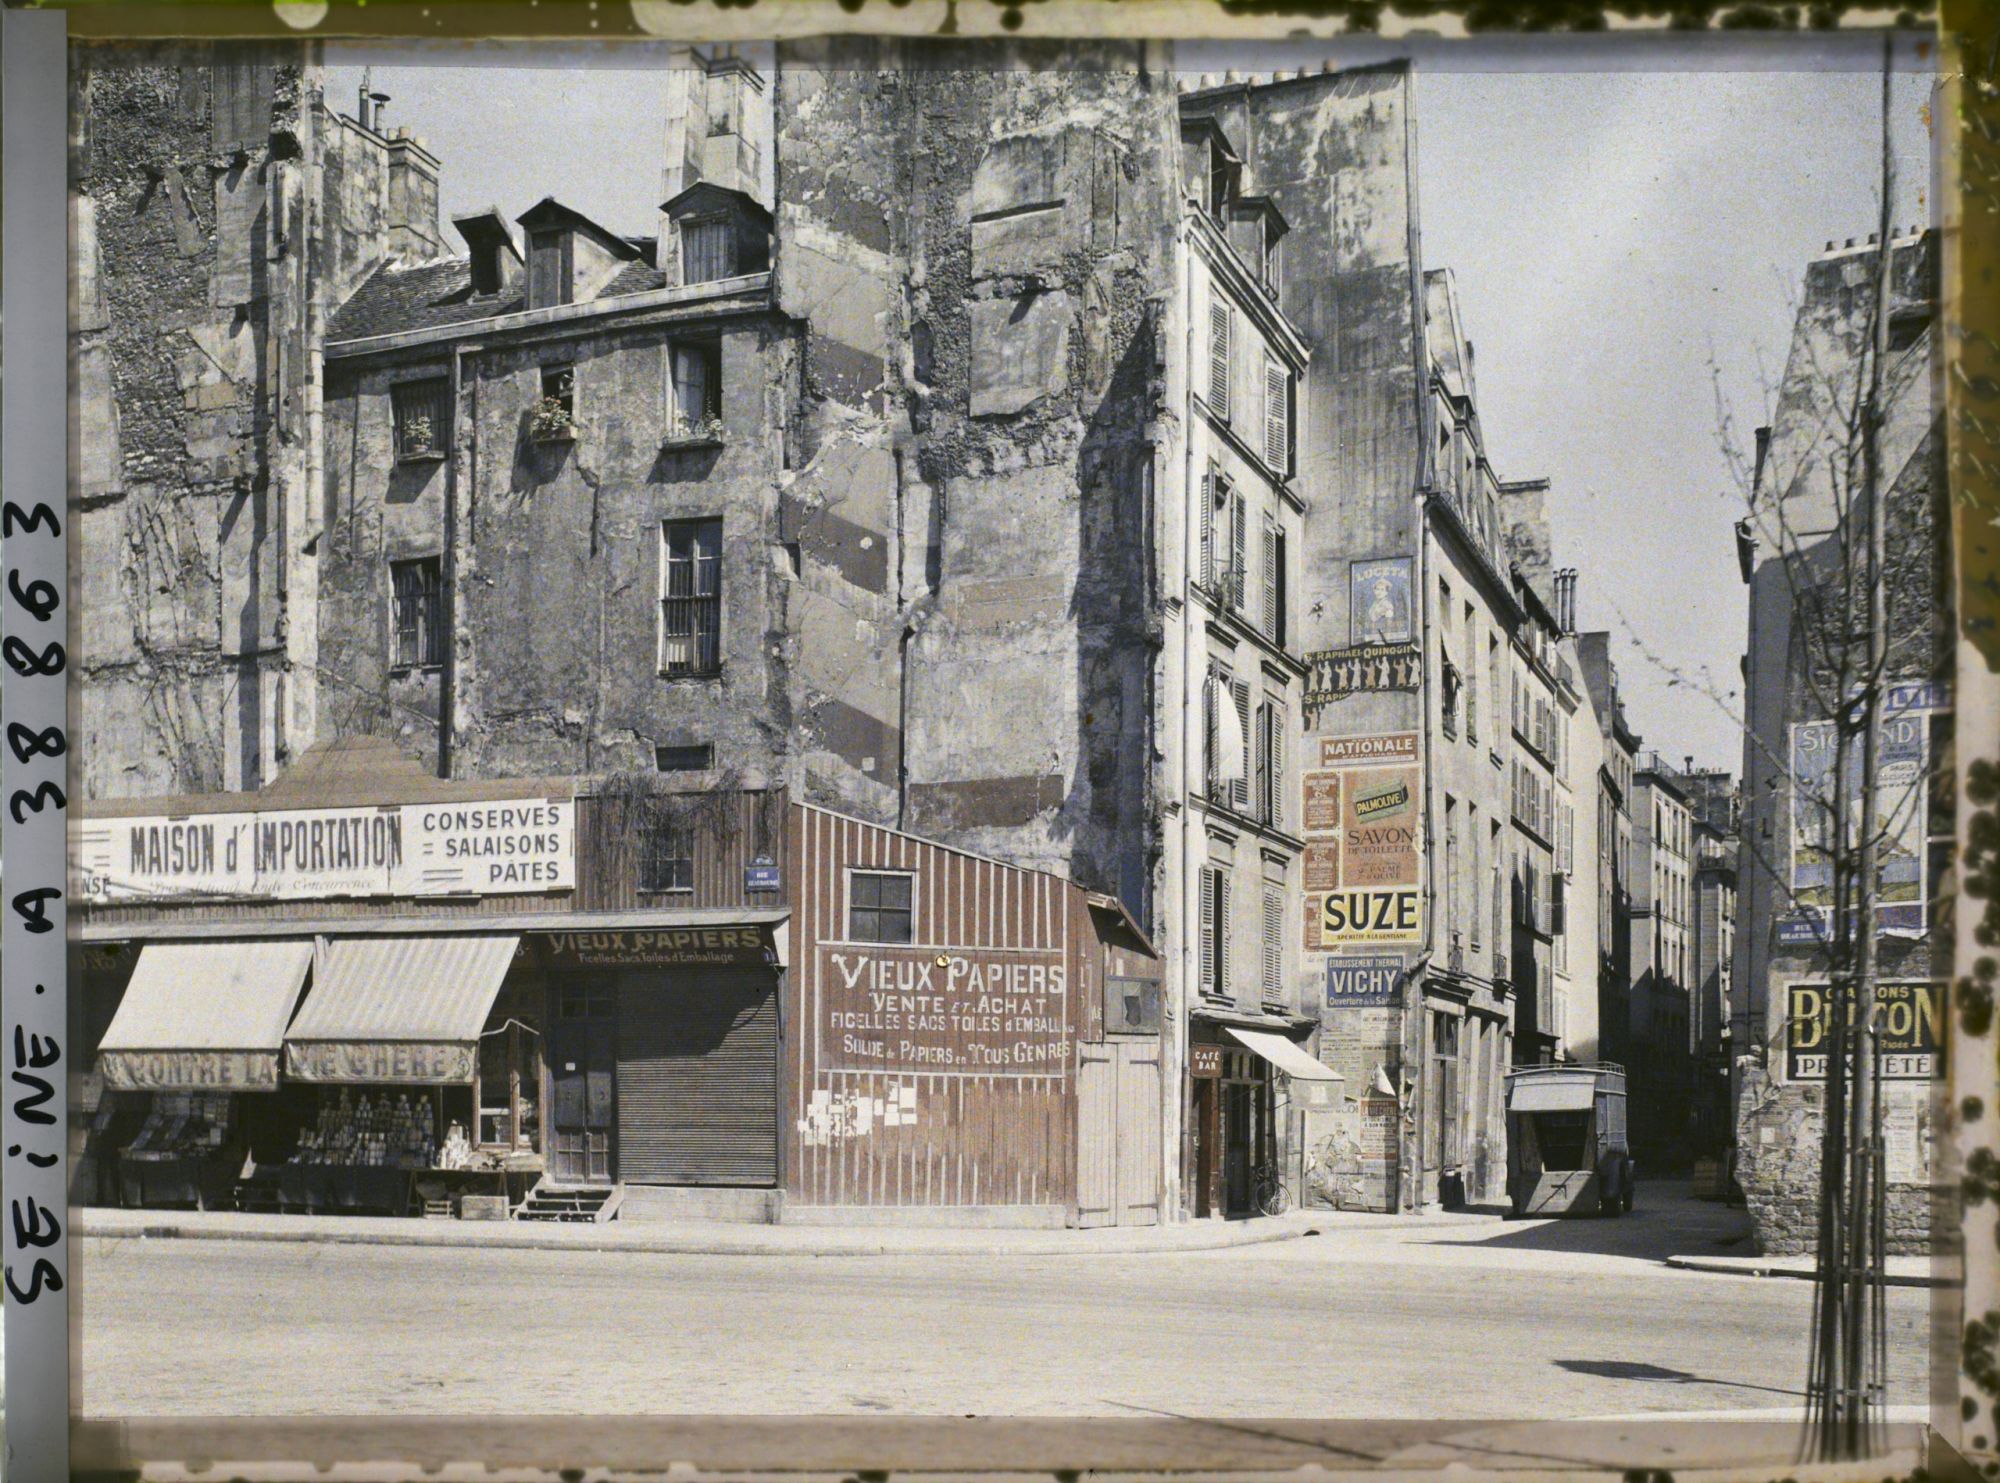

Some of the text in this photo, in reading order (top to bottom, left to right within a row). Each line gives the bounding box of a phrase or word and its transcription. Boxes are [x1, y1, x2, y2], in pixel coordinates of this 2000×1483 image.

[3, 502, 63, 824] 38863
[1325, 738, 1413, 756] NATIONALE
[1356, 792, 1401, 814] PALMOLIVE
[423, 806, 560, 832] CONSERVES
[446, 833, 560, 857] SALAISONS
[1348, 827, 1414, 846] SAVON
[131, 823, 215, 874] MAISON
[490, 859, 560, 882] PÂTES
[1325, 891, 1418, 931] SUZE
[548, 932, 626, 955] VIEUX
[632, 929, 761, 953] PAPIERS
[831, 953, 1064, 994] VIEUX PAPIERS
[1375, 957, 1402, 968] THERMAL
[1332, 969, 1398, 994] VICHY
[869, 992, 945, 1013] VENTE
[973, 995, 1047, 1015] ACHAT
[1329, 996, 1363, 1006] Ouverture
[831, 1012, 901, 1030] FICELLES
[908, 1014, 946, 1031] SACS
[951, 1016, 1000, 1032] TOILES
[1195, 1050, 1219, 1061] CAFÉ
[1198, 1061, 1217, 1071] BAR
